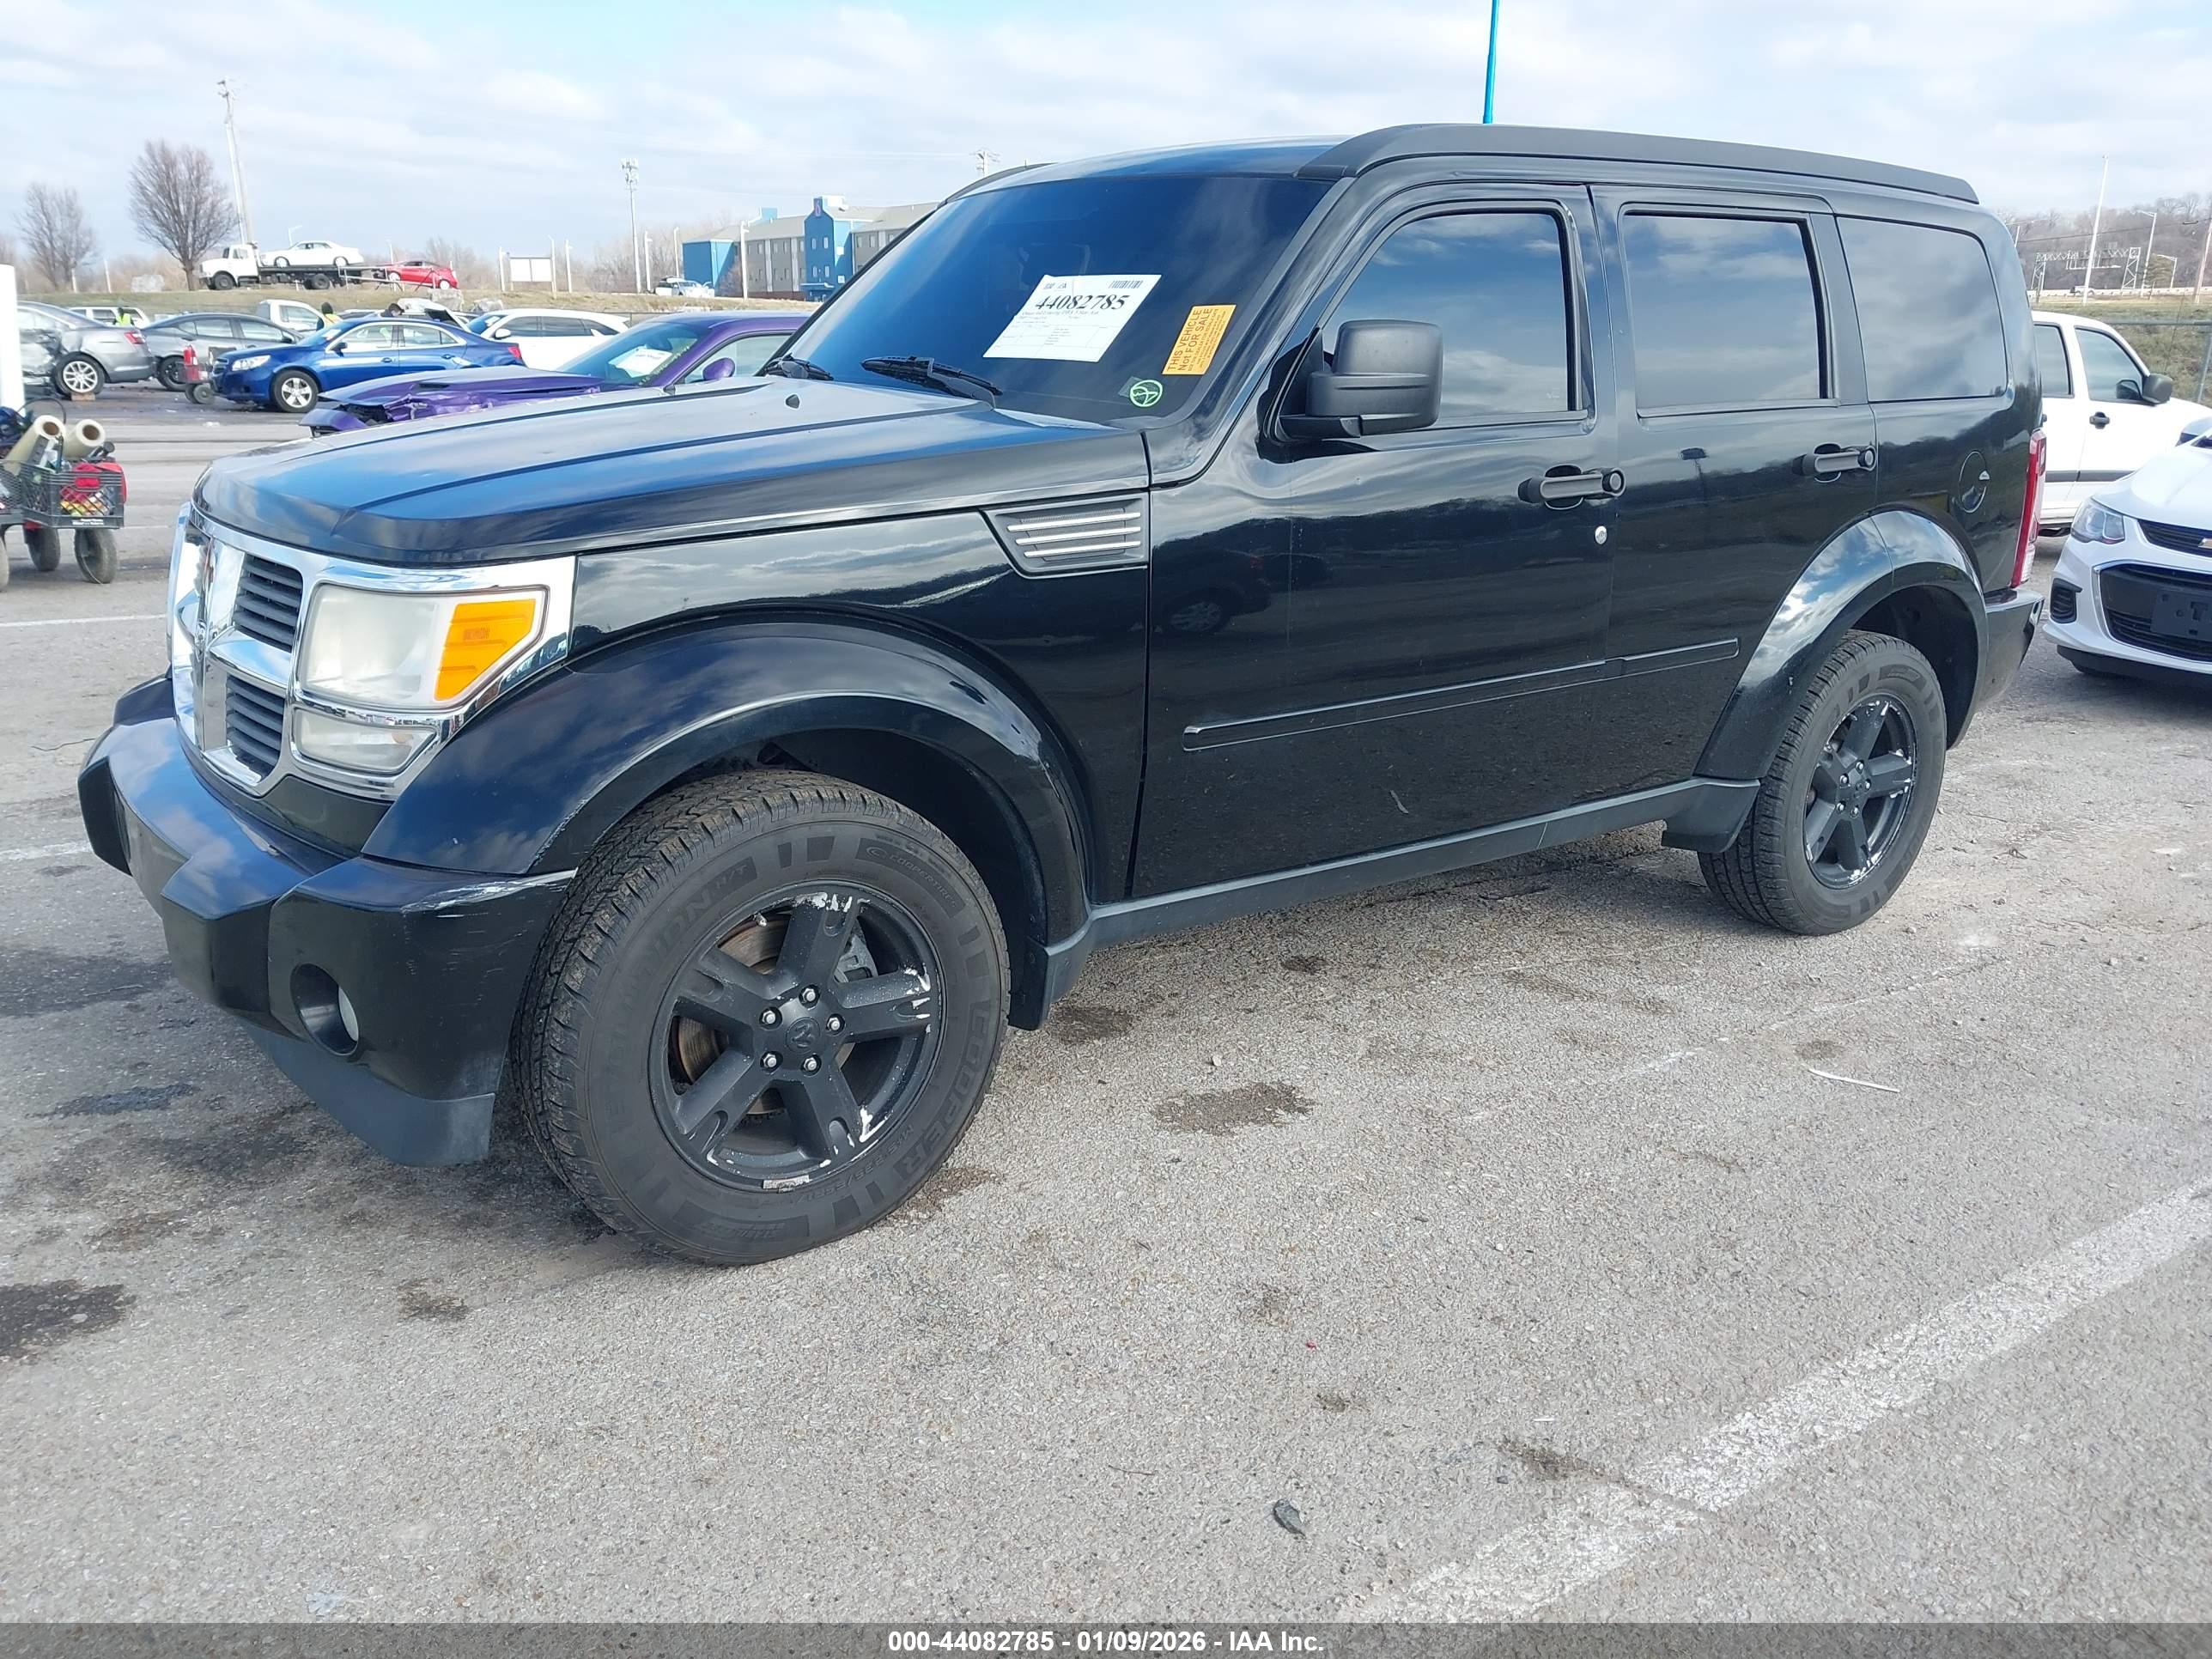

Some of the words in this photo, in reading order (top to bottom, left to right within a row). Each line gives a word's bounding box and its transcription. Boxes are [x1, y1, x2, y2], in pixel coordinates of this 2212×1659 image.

[1035, 295, 1131, 310] 44082785
[1166, 350, 1183, 371] THIS
[1177, 309, 1202, 347] VEHICLE
[1185, 333, 1200, 353] FOR
[1194, 308, 1212, 331] SALE
[902, 1007, 990, 1175] COOPER
